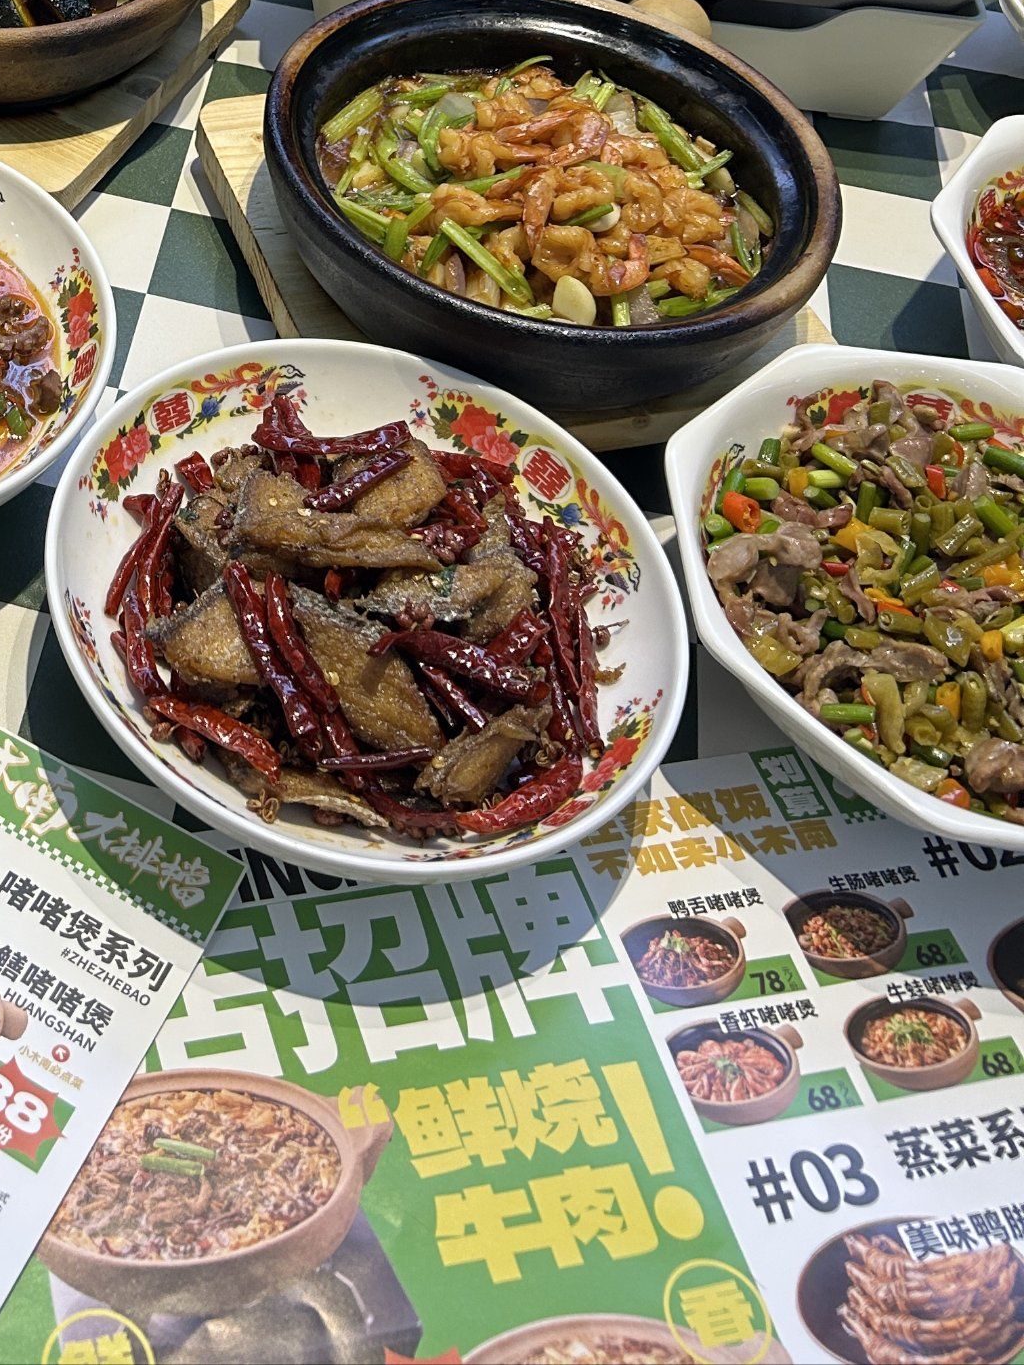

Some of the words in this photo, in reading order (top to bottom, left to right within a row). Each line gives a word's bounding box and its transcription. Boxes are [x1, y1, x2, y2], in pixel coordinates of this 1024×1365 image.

[757, 753, 833, 819] 划算
[587, 818, 839, 881] 不如来小木南
[828, 865, 921, 895] 生肠啫啫煲
[667, 886, 765, 920] 鸭舌啫啫煲
[916, 943, 948, 967] 68
[60, 947, 152, 1008] #ZHEZHEBAO
[749, 969, 787, 995] 78
[887, 970, 983, 1003] 牛蛙啫啫煲
[4, 987, 98, 1054] HUANGSHAN
[720, 998, 820, 1033] 香虾啫啫煲
[981, 1051, 1015, 1078] 68
[808, 1084, 843, 1113] 68
[744, 1141, 881, 1225] #03
[434, 1162, 660, 1284] 牛肉
